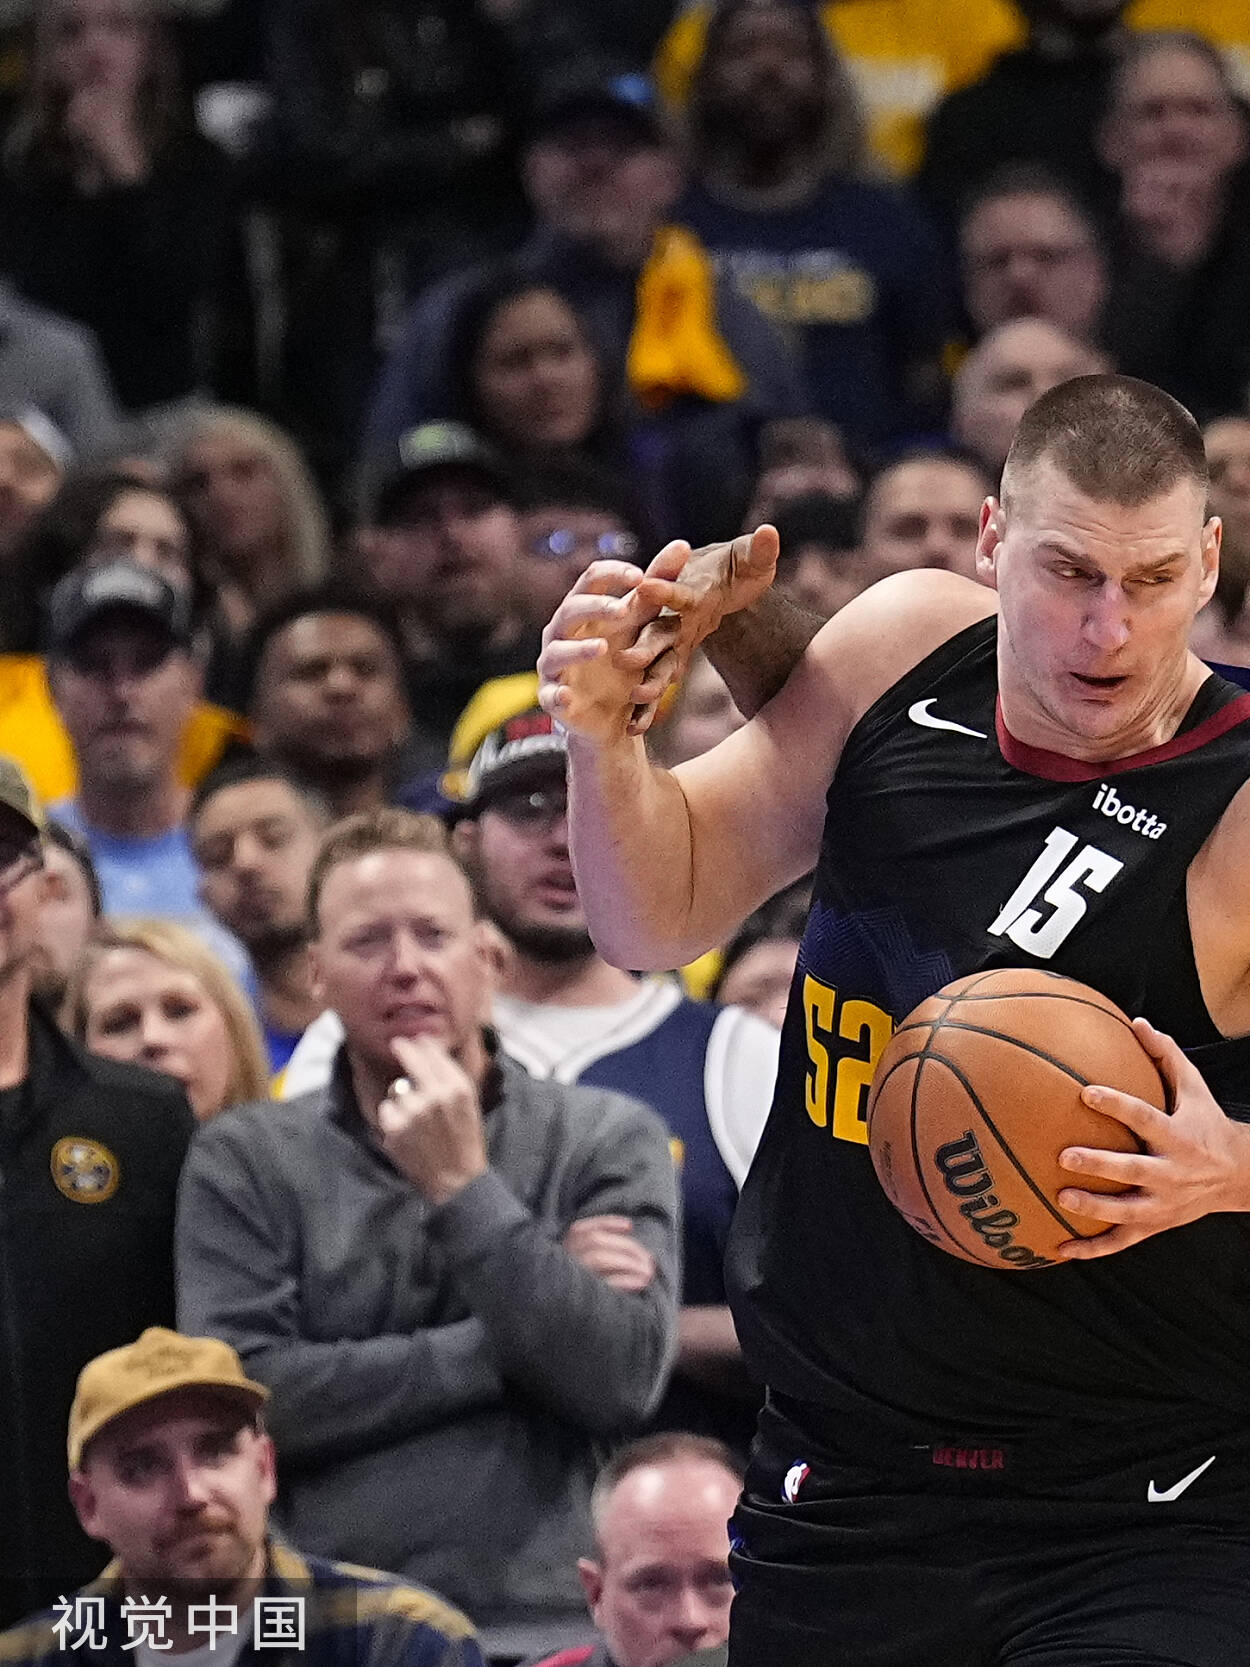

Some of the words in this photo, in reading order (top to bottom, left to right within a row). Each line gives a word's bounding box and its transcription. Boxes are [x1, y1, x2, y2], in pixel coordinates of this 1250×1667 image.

[1092, 783, 1167, 839] ibotta
[986, 825, 1125, 960] 15
[932, 1448, 1004, 1470] DENVER
